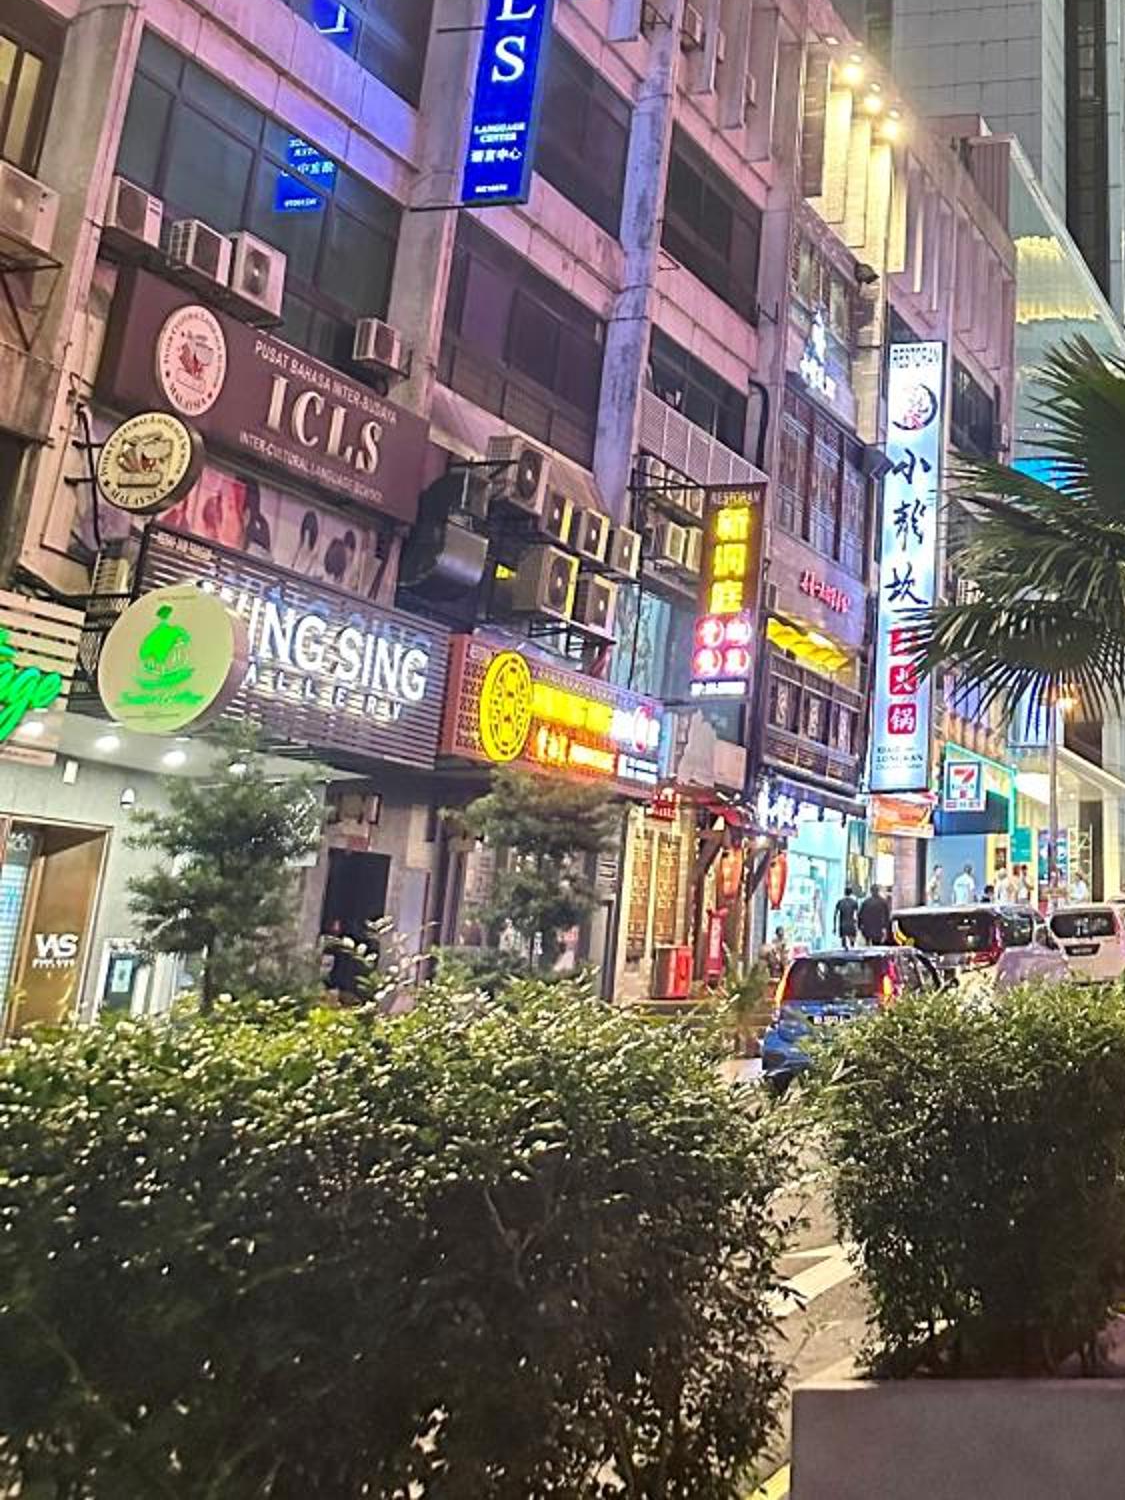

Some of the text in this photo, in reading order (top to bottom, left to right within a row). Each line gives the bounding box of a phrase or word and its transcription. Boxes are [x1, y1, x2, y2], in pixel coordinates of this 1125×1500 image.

[255, 339, 289, 369] PUSAT
[289, 360, 331, 391] BAHASA
[267, 373, 383, 474] ICLS
[242, 662, 402, 721] ALLERY
